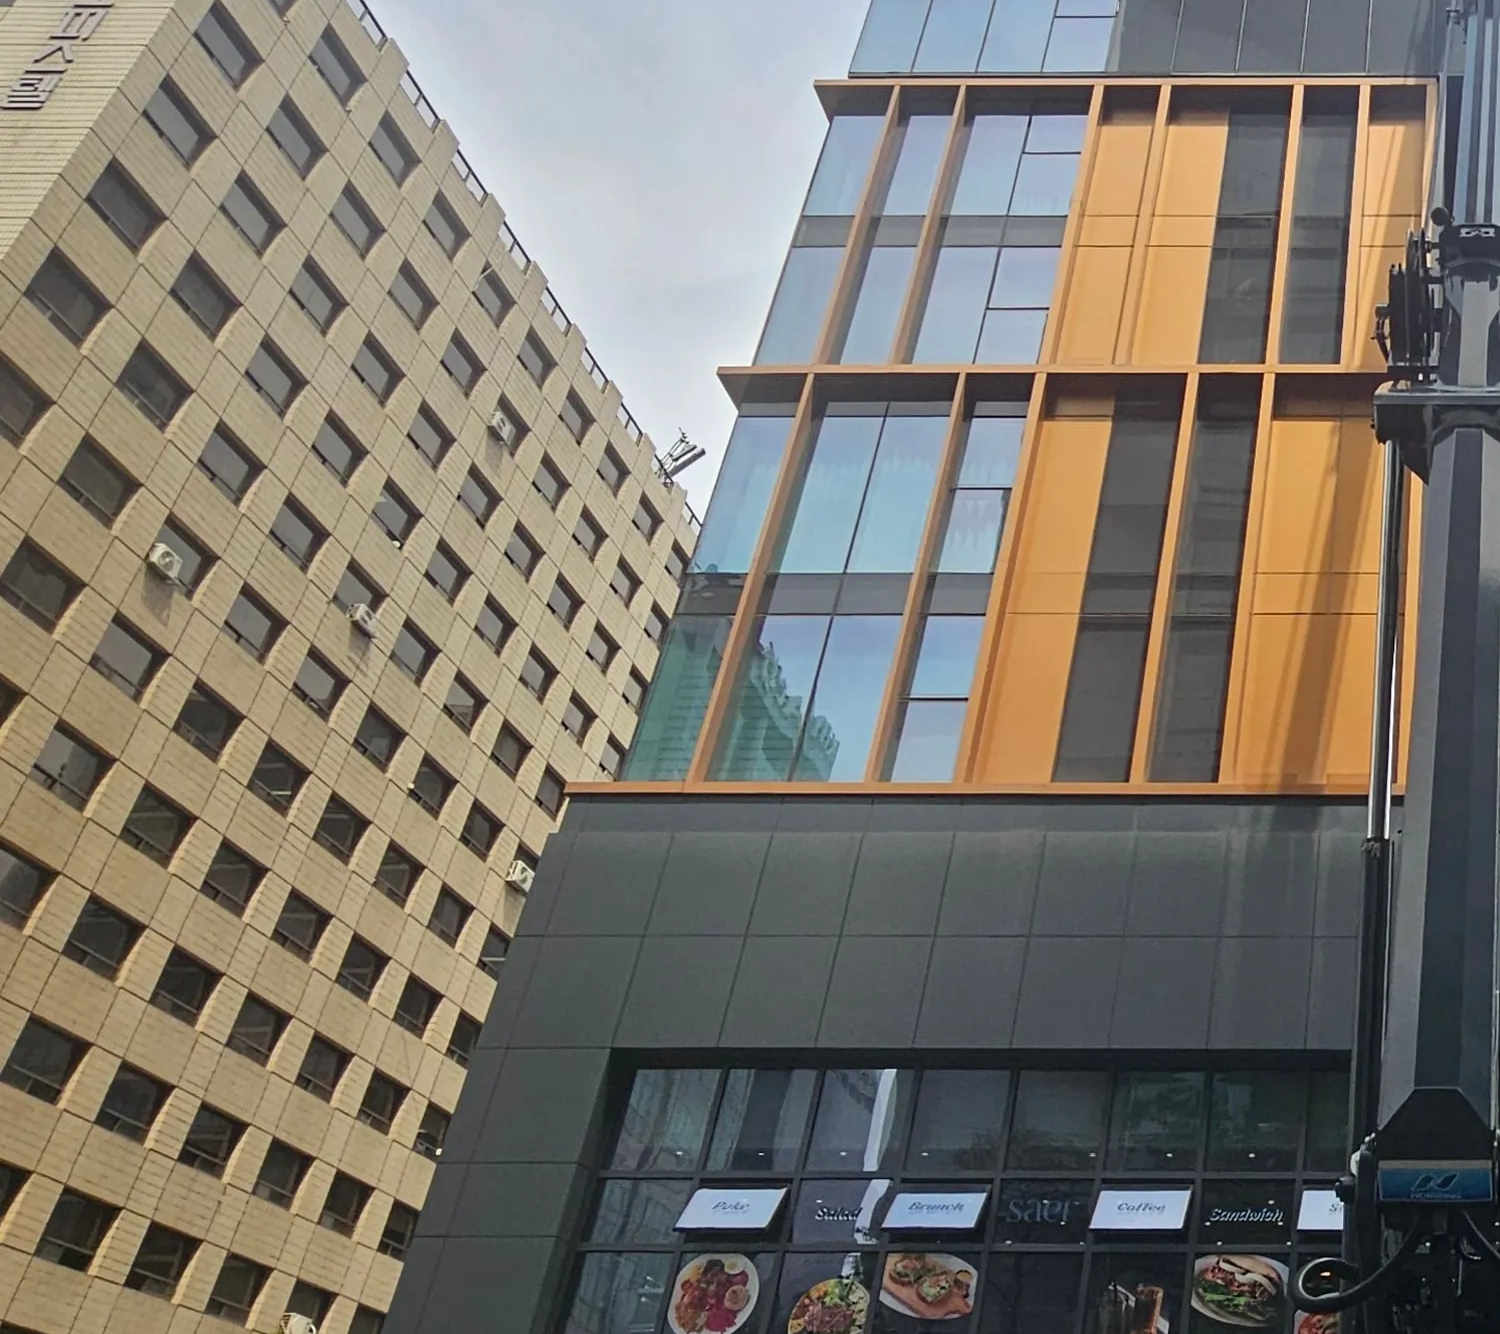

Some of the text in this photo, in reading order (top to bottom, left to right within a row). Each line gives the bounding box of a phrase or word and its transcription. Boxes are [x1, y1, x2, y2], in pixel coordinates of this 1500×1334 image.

[907, 1198, 965, 1213] Brunch
[1116, 1201, 1166, 1214] Coffee
[815, 1207, 863, 1222] Salad
[1209, 1208, 1285, 1223] Sandwich
